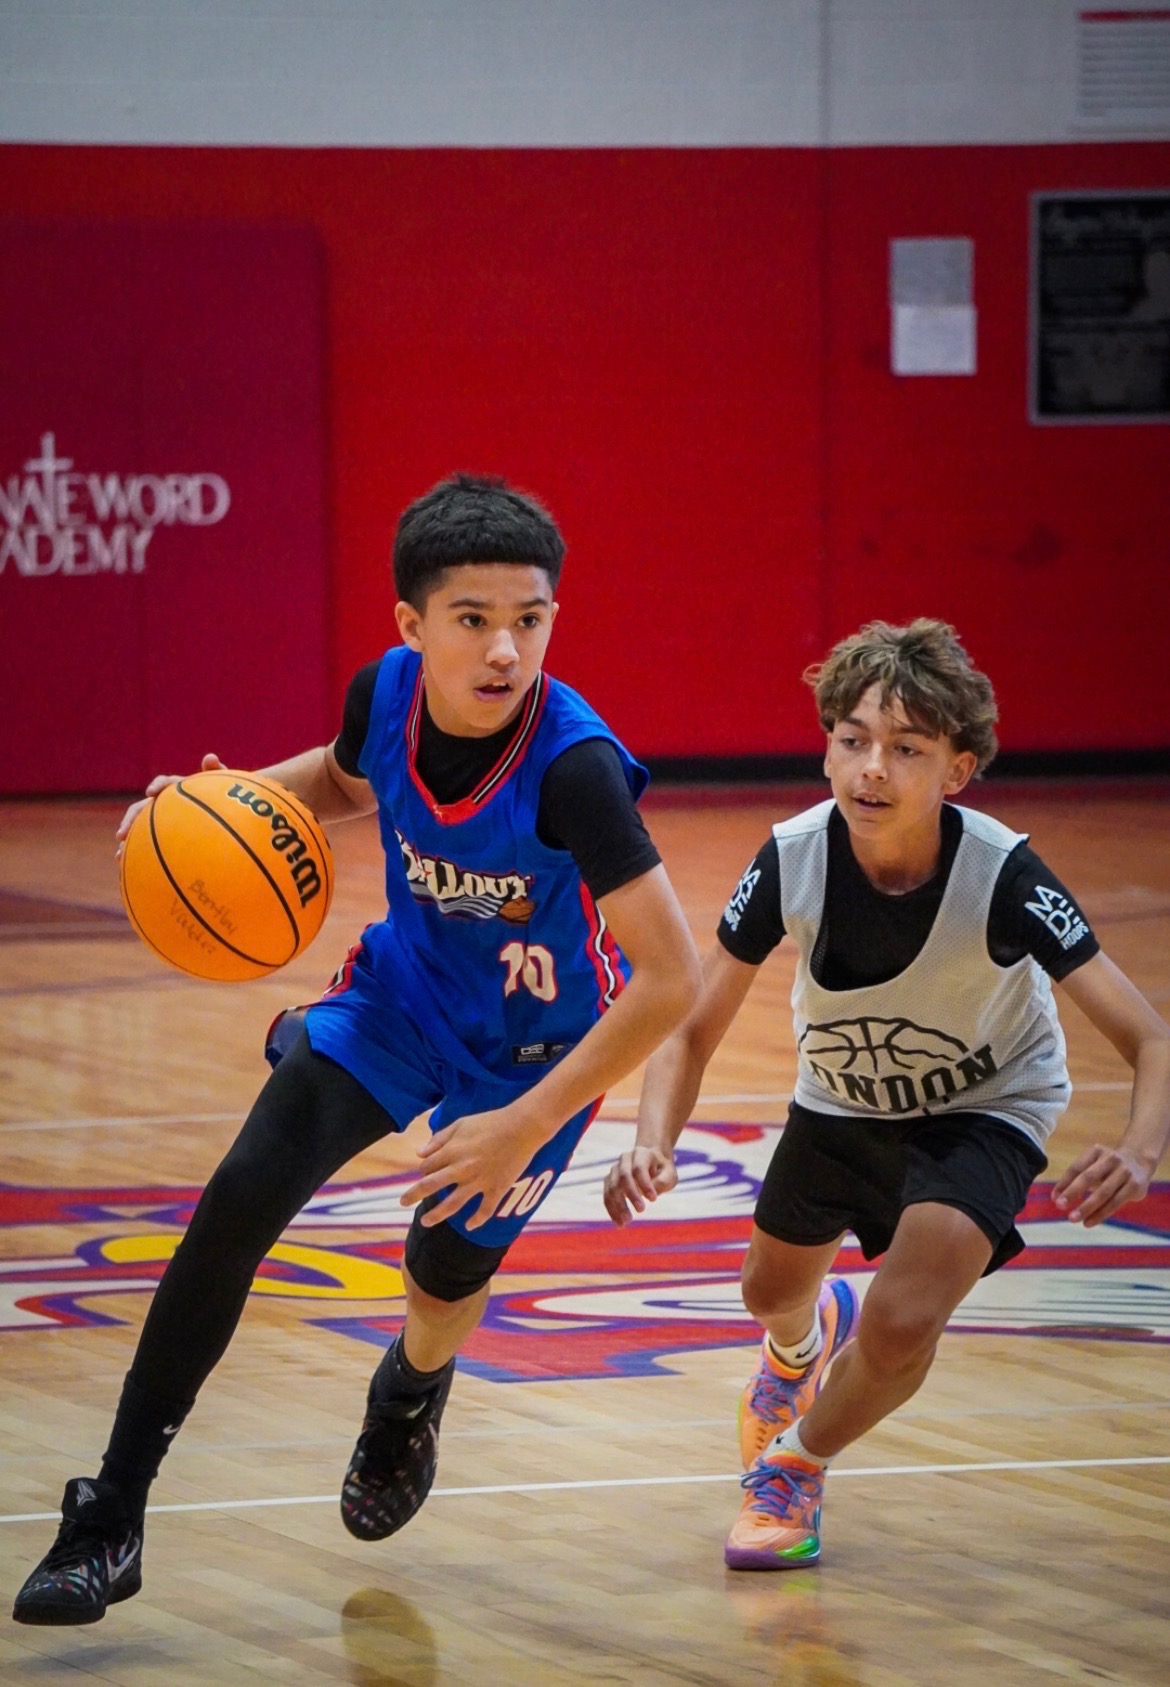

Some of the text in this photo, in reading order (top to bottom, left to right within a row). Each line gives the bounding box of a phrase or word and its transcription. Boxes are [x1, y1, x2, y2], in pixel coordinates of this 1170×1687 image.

[86, 472, 231, 526] WORD
[226, 783, 321, 909] Wilson
[499, 941, 558, 1003] 10
[496, 1169, 554, 1218] 10
